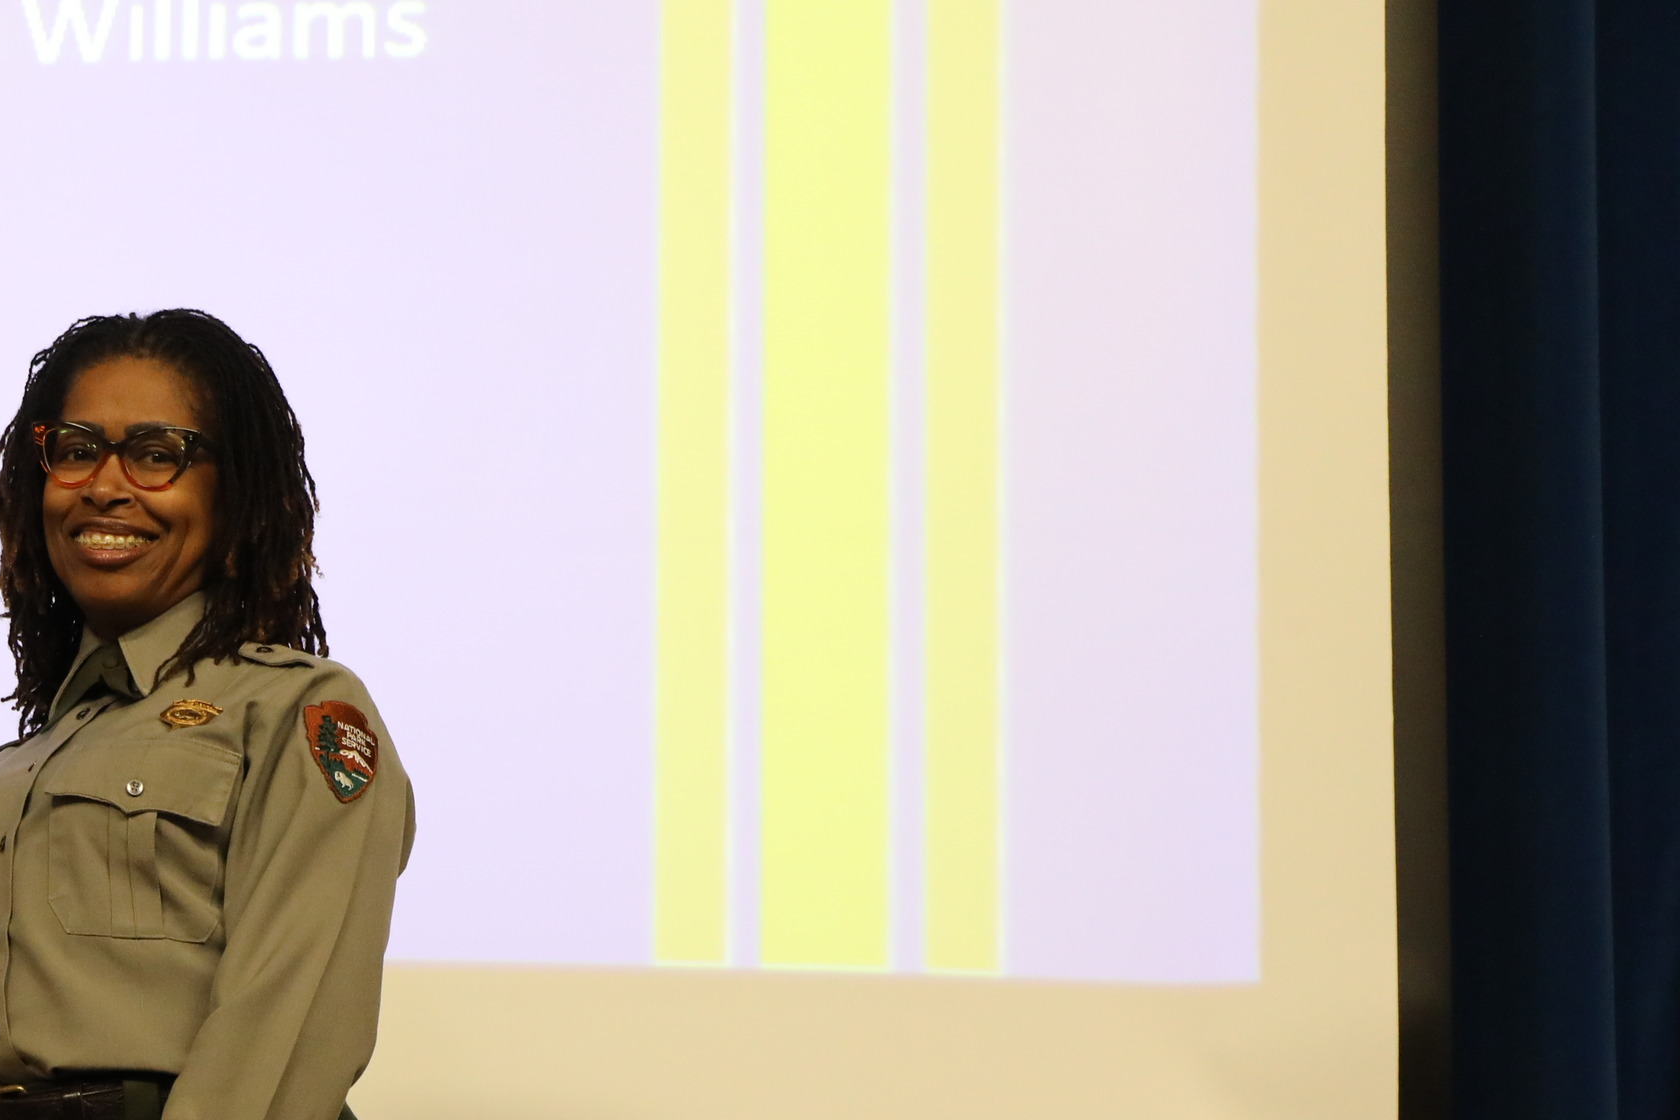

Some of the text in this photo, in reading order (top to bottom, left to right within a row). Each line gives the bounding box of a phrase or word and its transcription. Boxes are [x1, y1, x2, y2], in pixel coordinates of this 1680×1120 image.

[23, 0, 428, 65] Williams
[337, 720, 376, 747] NATIONAL
[346, 731, 366, 747] PARK
[341, 736, 372, 758] SERVICE
